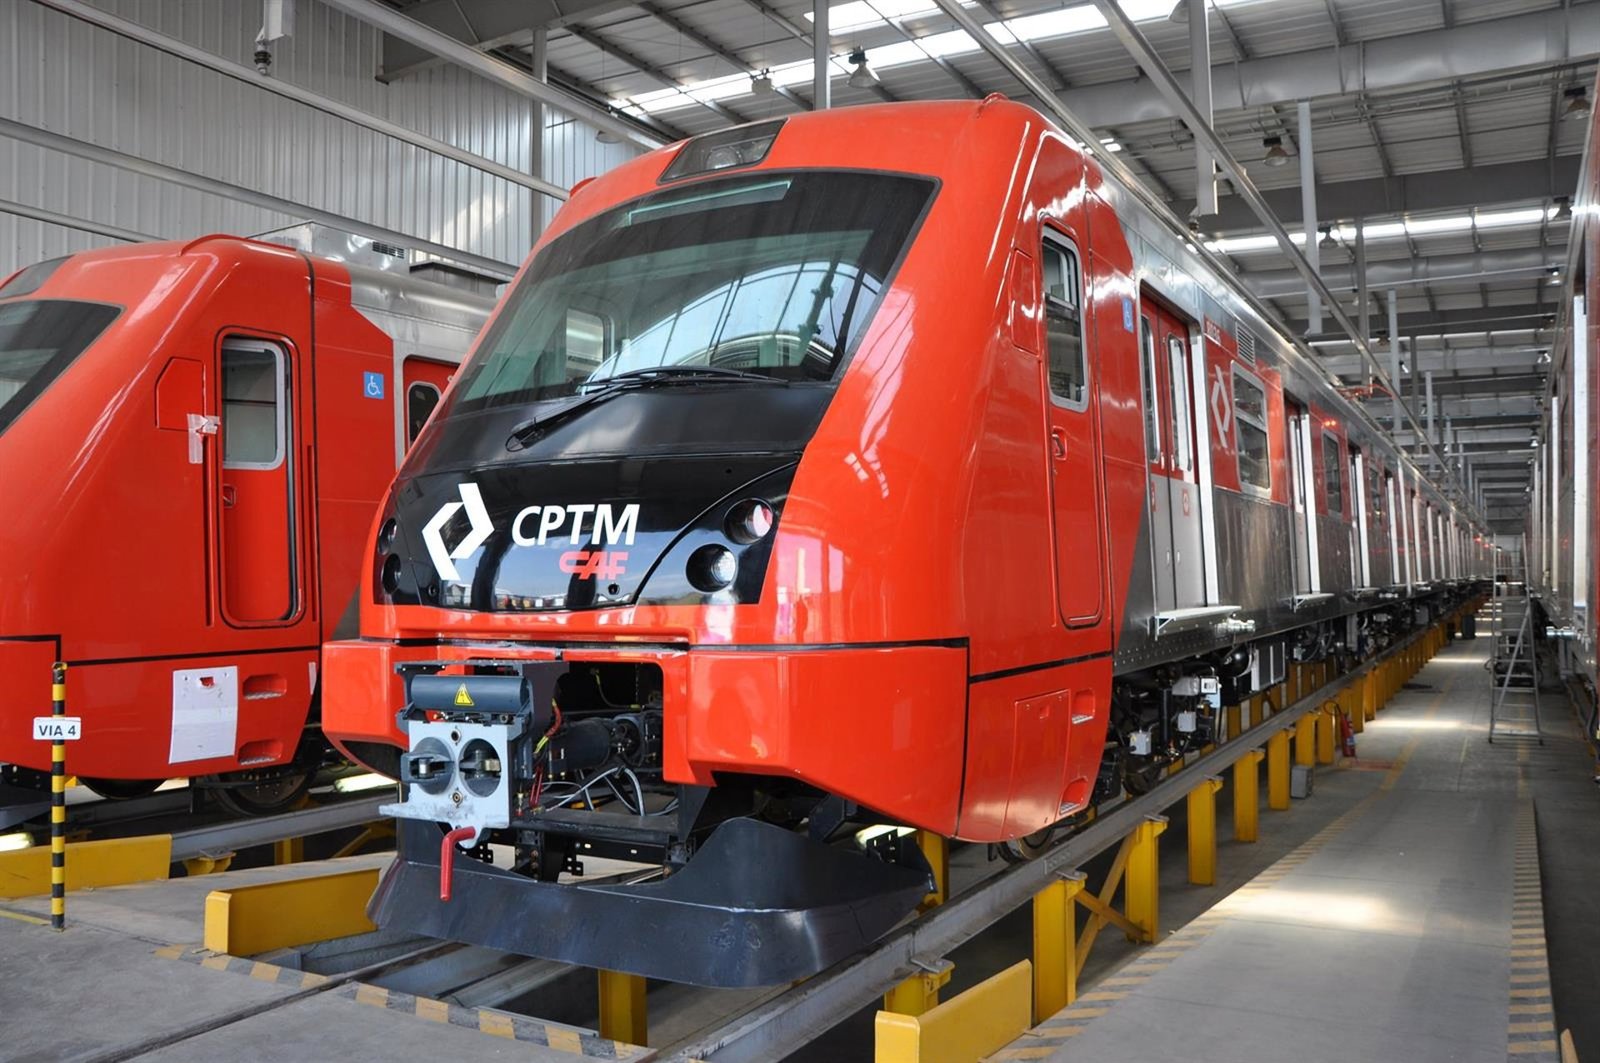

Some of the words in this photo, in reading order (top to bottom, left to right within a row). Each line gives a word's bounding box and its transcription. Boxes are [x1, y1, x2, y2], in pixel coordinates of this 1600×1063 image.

[511, 503, 641, 547] CPTM
[559, 551, 629, 580] CAF
[38, 724, 64, 737] VIA
[67, 724, 77, 737] 4
